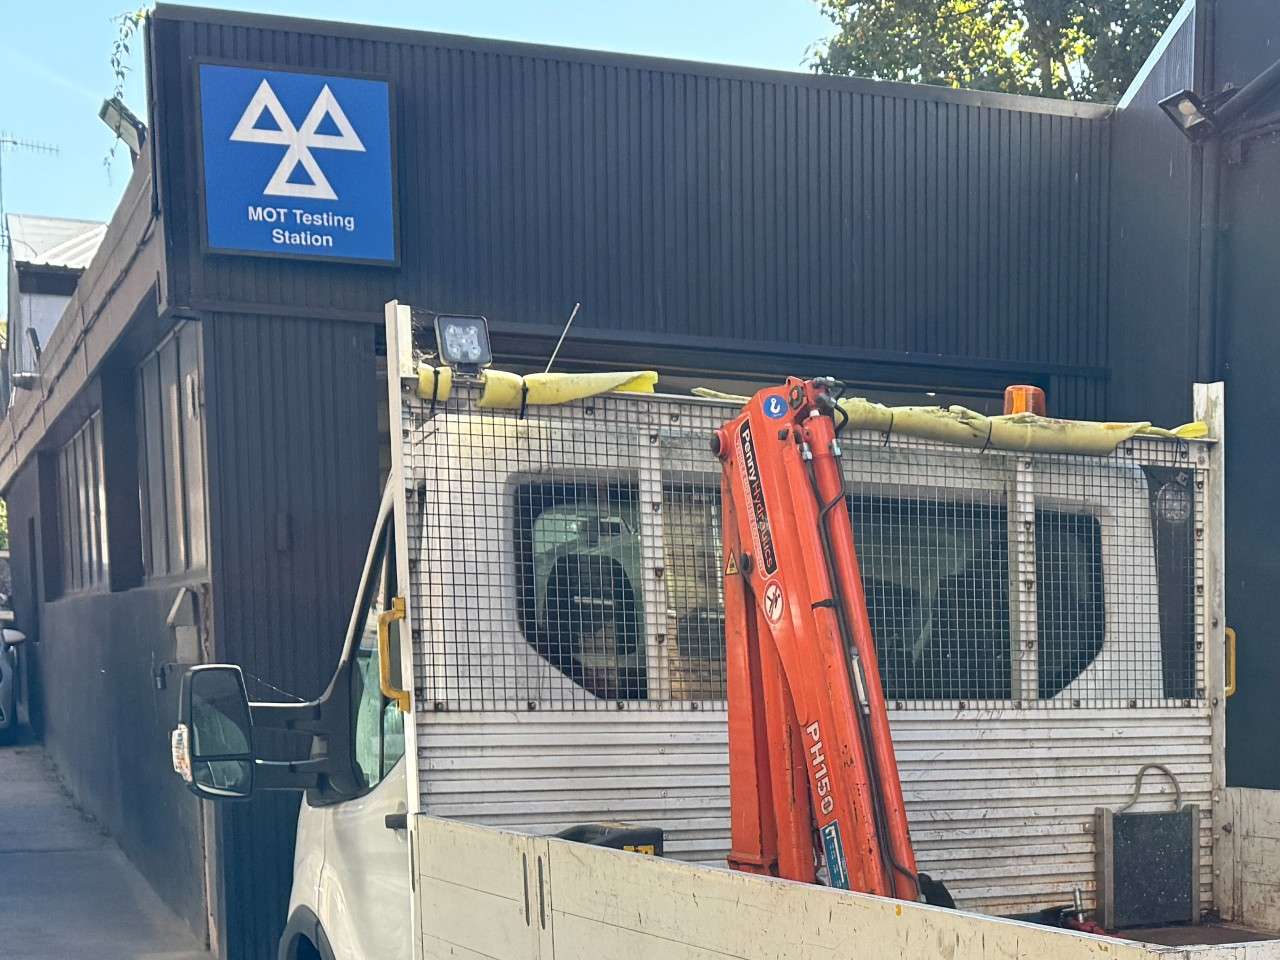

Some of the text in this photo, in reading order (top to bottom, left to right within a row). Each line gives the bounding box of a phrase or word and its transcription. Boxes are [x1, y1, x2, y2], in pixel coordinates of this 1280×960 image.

[248, 206, 355, 231] MOT Testing
[272, 228, 333, 247] Station
[742, 428, 757, 486] Penny
[806, 721, 834, 816] PH150
